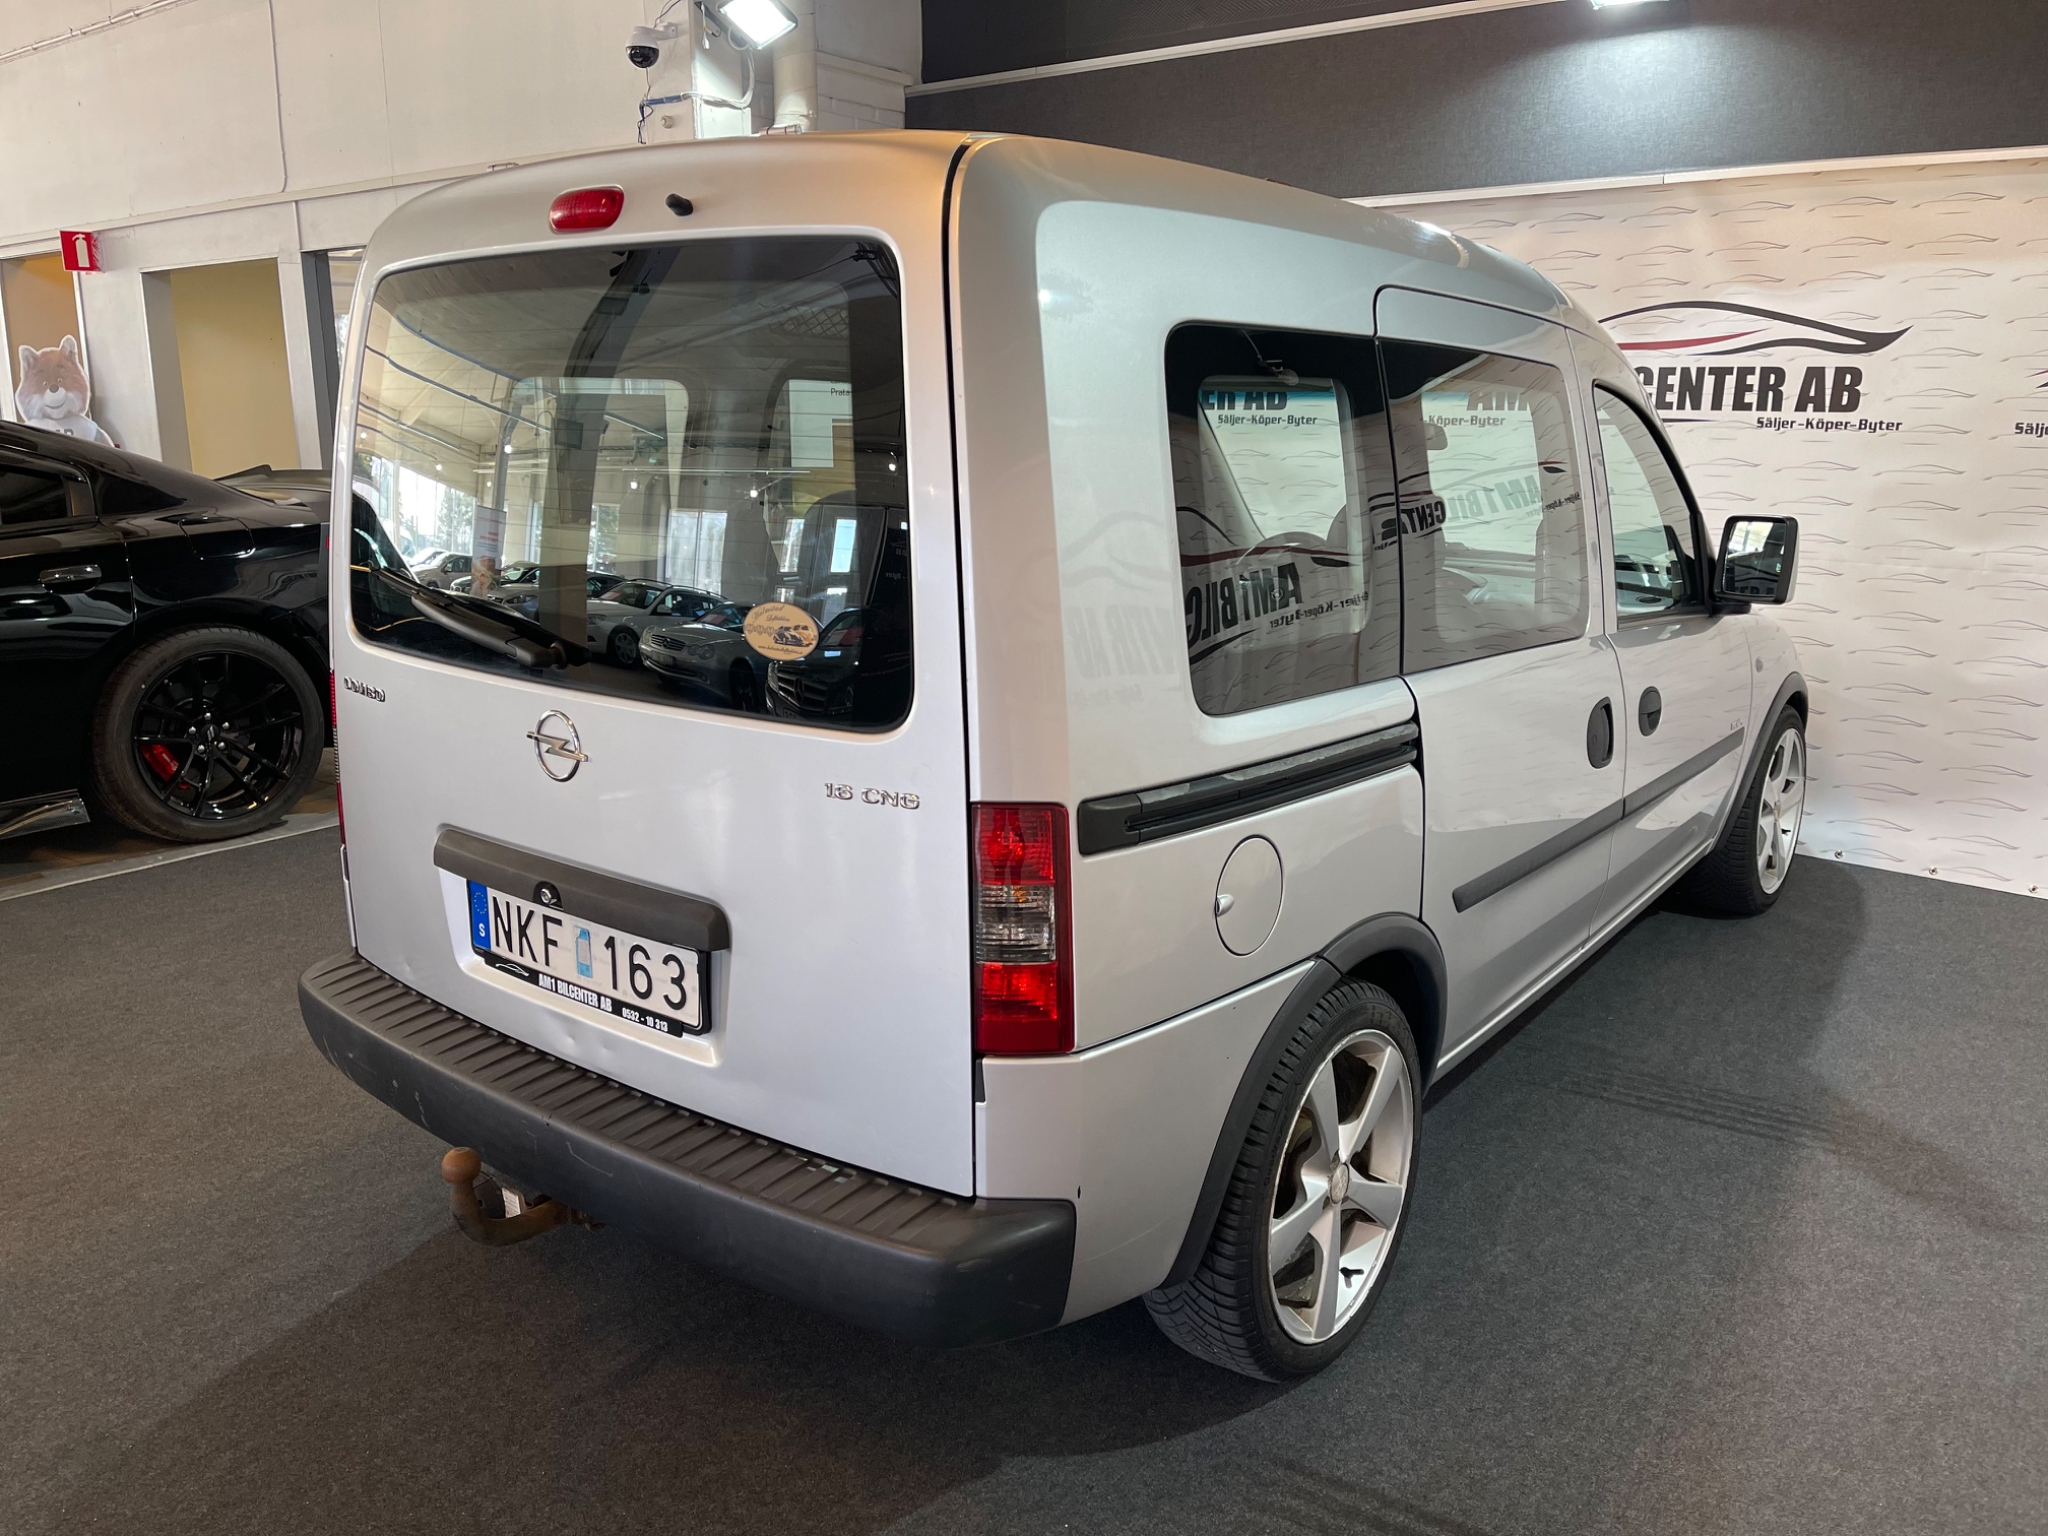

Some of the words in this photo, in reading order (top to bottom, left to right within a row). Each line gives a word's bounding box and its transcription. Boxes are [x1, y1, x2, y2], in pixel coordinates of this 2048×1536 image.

[1794, 366, 1863, 413] AB
[861, 787, 920, 810] CNG
[478, 922, 486, 938] S
[492, 896, 563, 967] NKF
[604, 935, 687, 1011] 163
[557, 979, 599, 1008] BILCENTER
[600, 994, 613, 1013] AB
